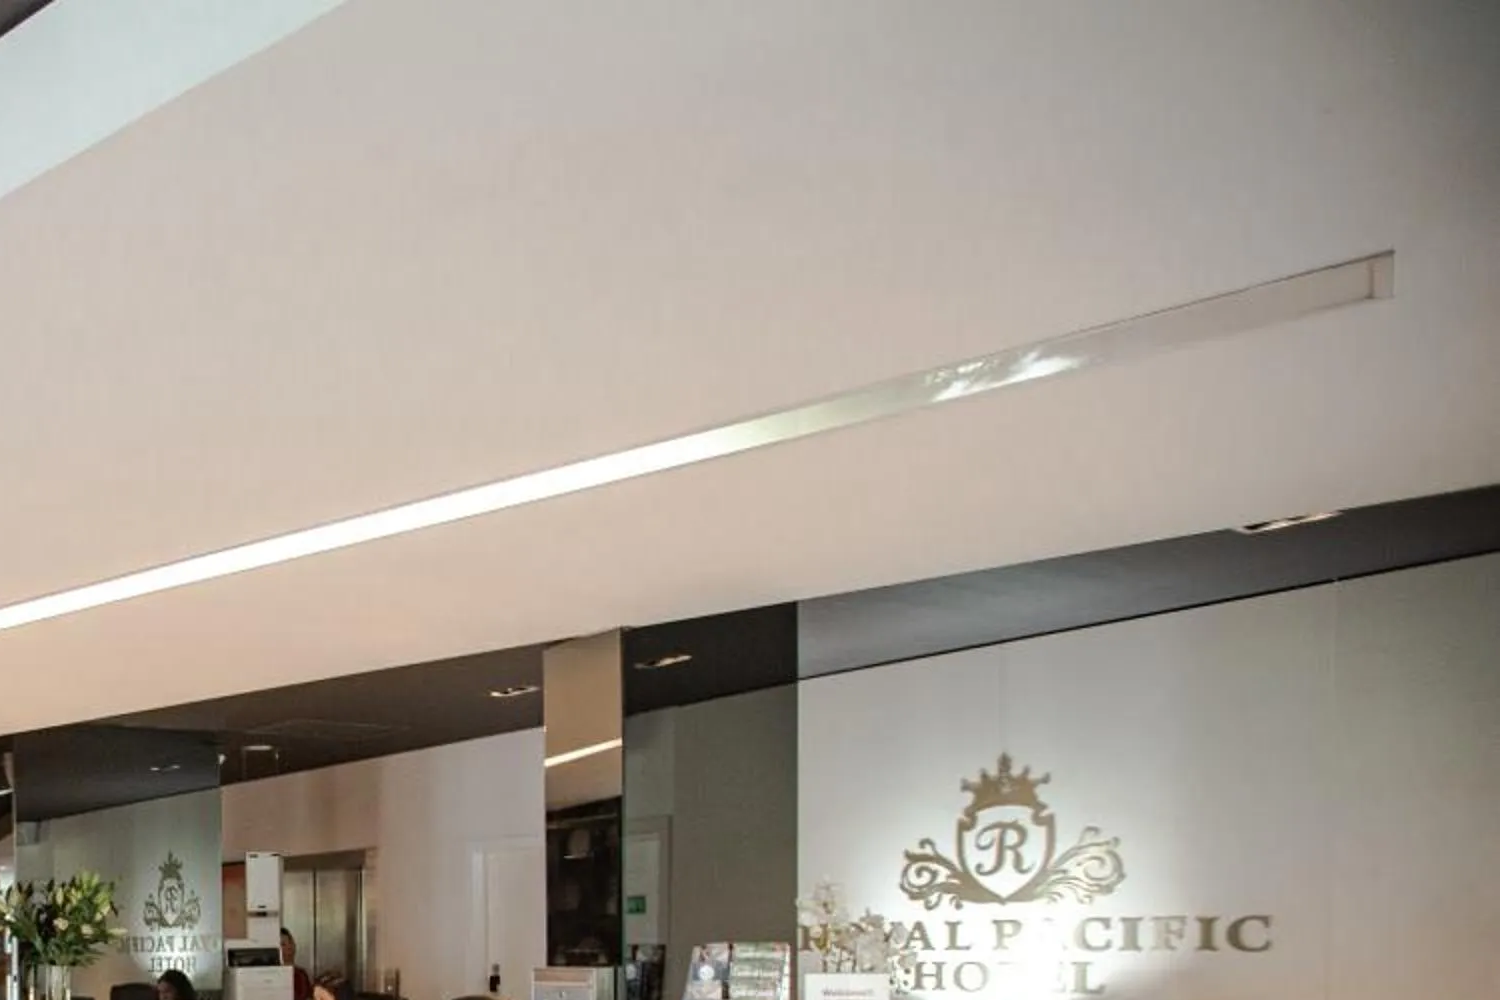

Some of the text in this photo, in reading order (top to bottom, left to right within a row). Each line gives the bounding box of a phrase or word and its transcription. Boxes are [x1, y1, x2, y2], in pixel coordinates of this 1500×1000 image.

[975, 821, 1037, 876] R
[989, 914, 1273, 952] PCIFIC
[910, 961, 1106, 995] HOL
